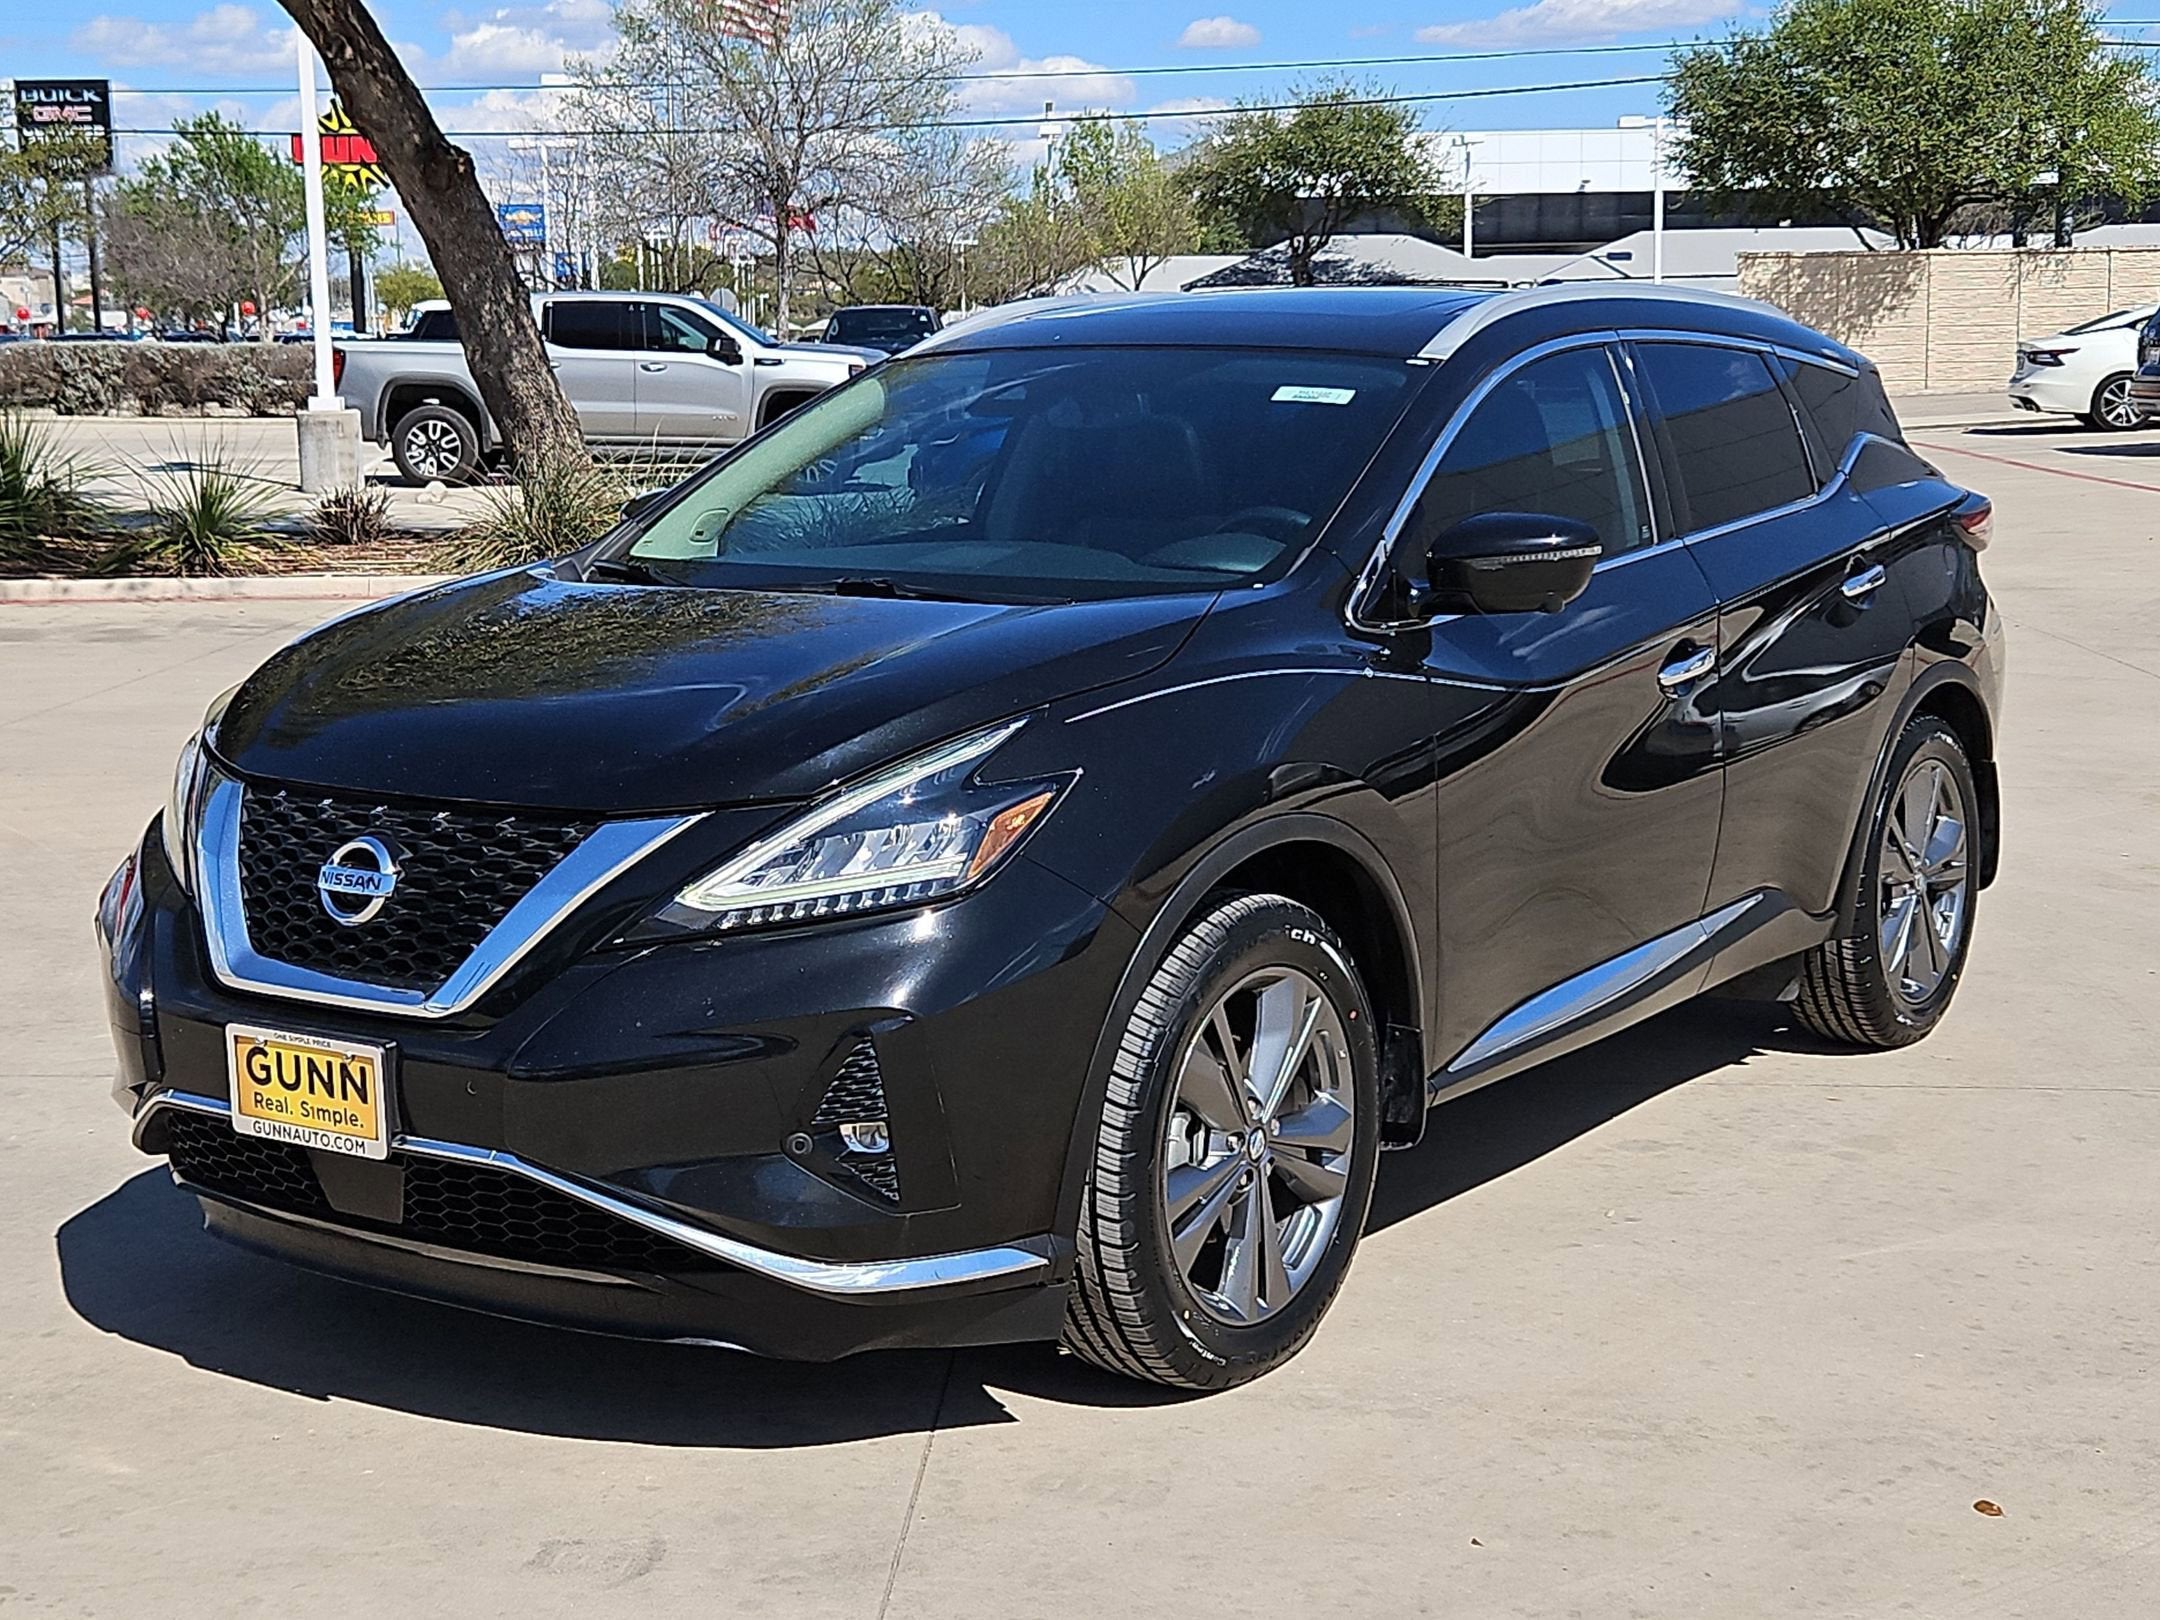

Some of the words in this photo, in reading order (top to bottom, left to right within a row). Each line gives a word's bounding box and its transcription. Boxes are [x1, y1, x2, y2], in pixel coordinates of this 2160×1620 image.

[20, 88, 103, 103] BUICK
[33, 105, 93, 122] GMC
[320, 870, 383, 892] NISSAN
[273, 1032, 288, 1041] ONE
[288, 1034, 311, 1046] SIMPLE
[311, 1038, 332, 1049] PRICE
[246, 1046, 369, 1105] GUNN
[253, 1091, 294, 1116] Real.
[252, 1119, 366, 1155] GUNNAUTO.COM
